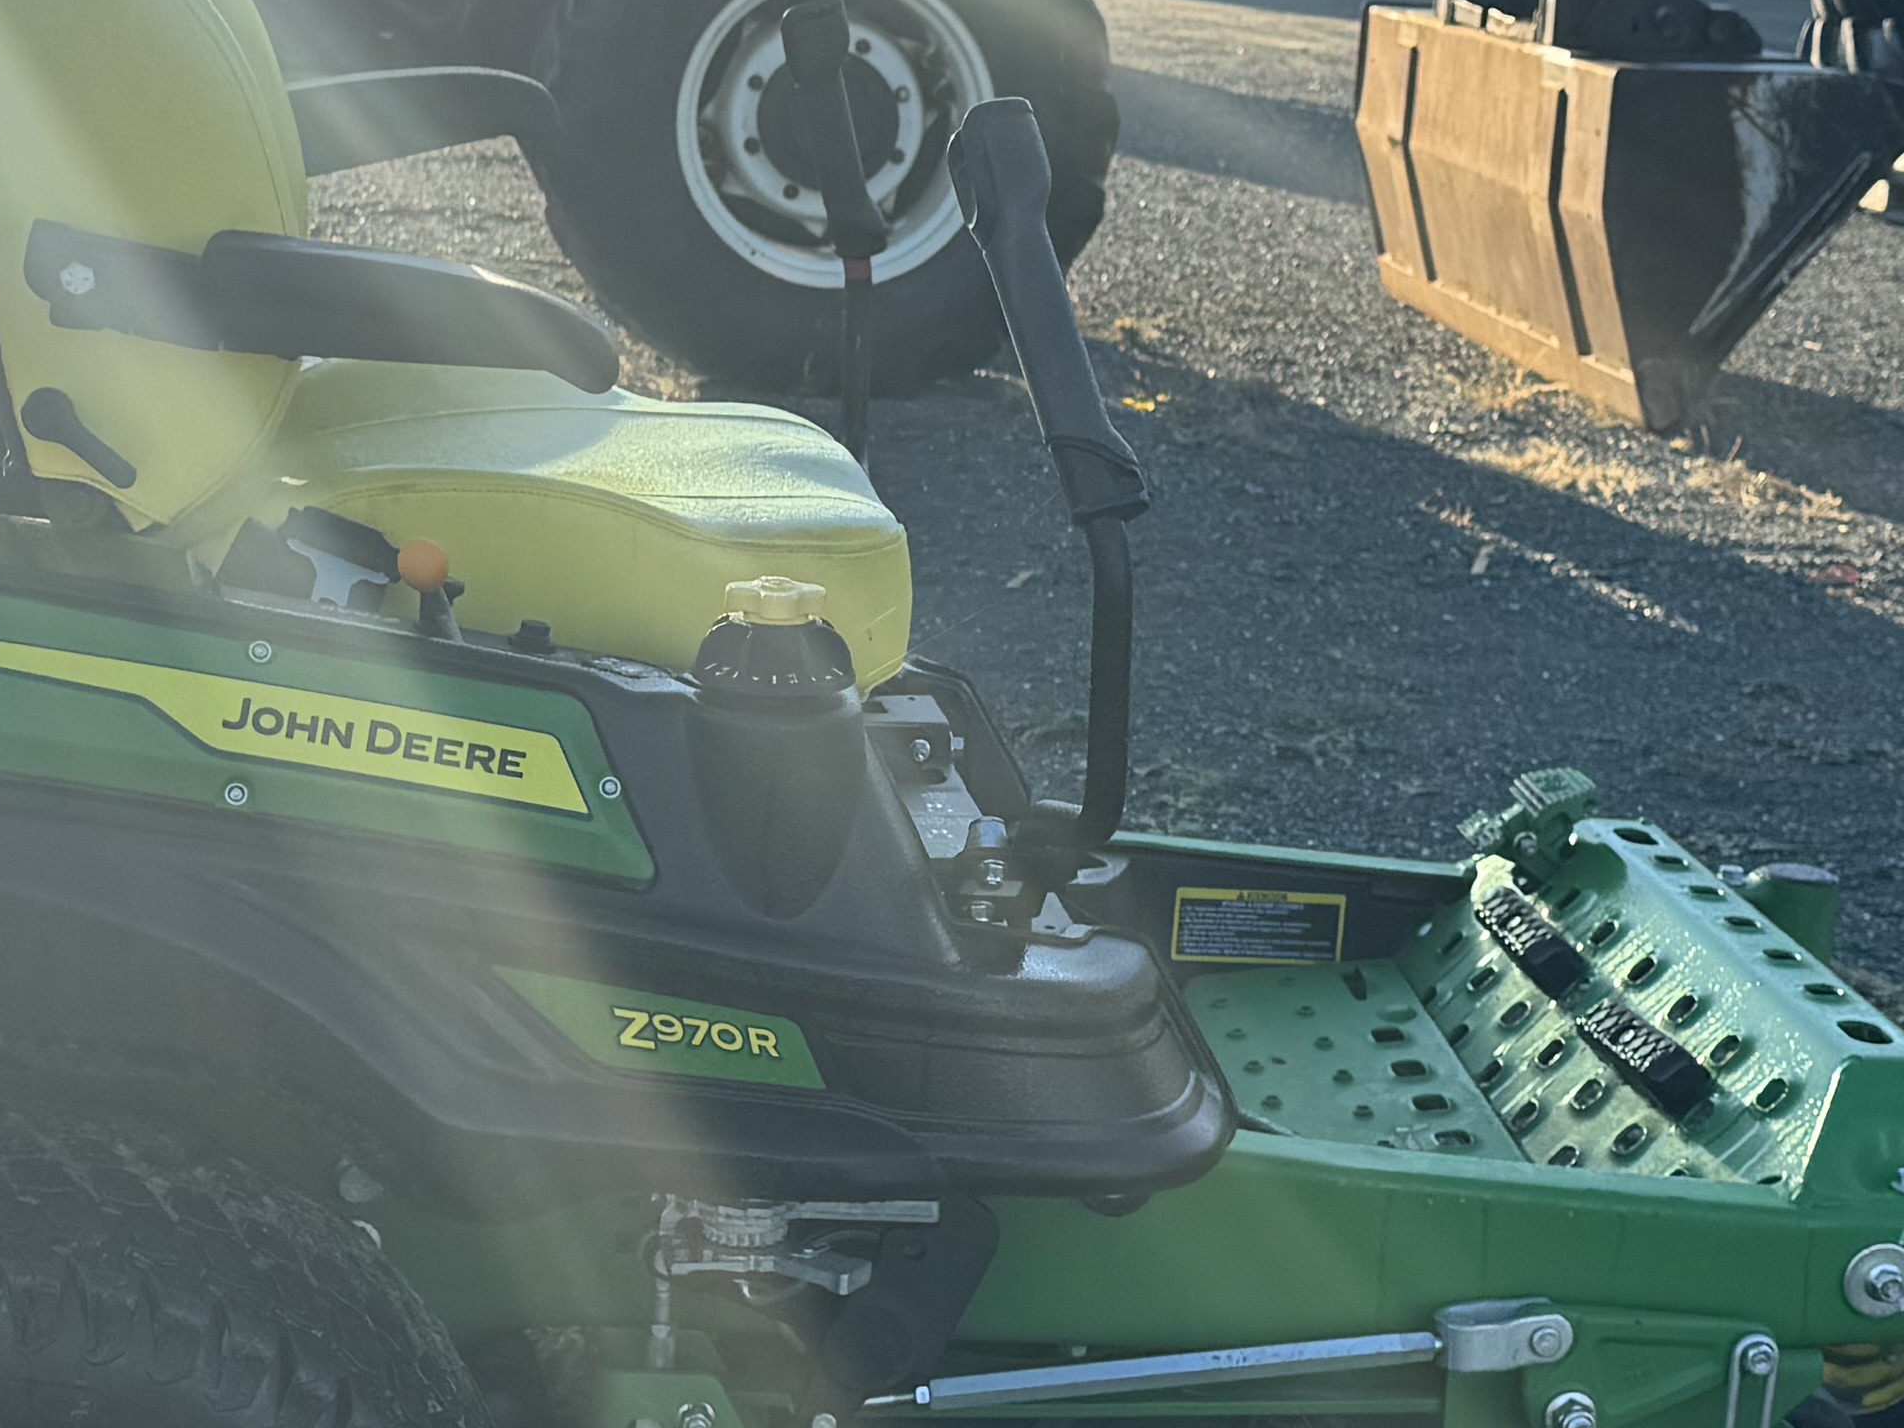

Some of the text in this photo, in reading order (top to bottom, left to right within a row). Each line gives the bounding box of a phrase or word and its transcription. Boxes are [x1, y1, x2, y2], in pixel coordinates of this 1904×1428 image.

[221, 695, 527, 781] JOHN DEERE
[609, 1005, 781, 1060] Z970R
